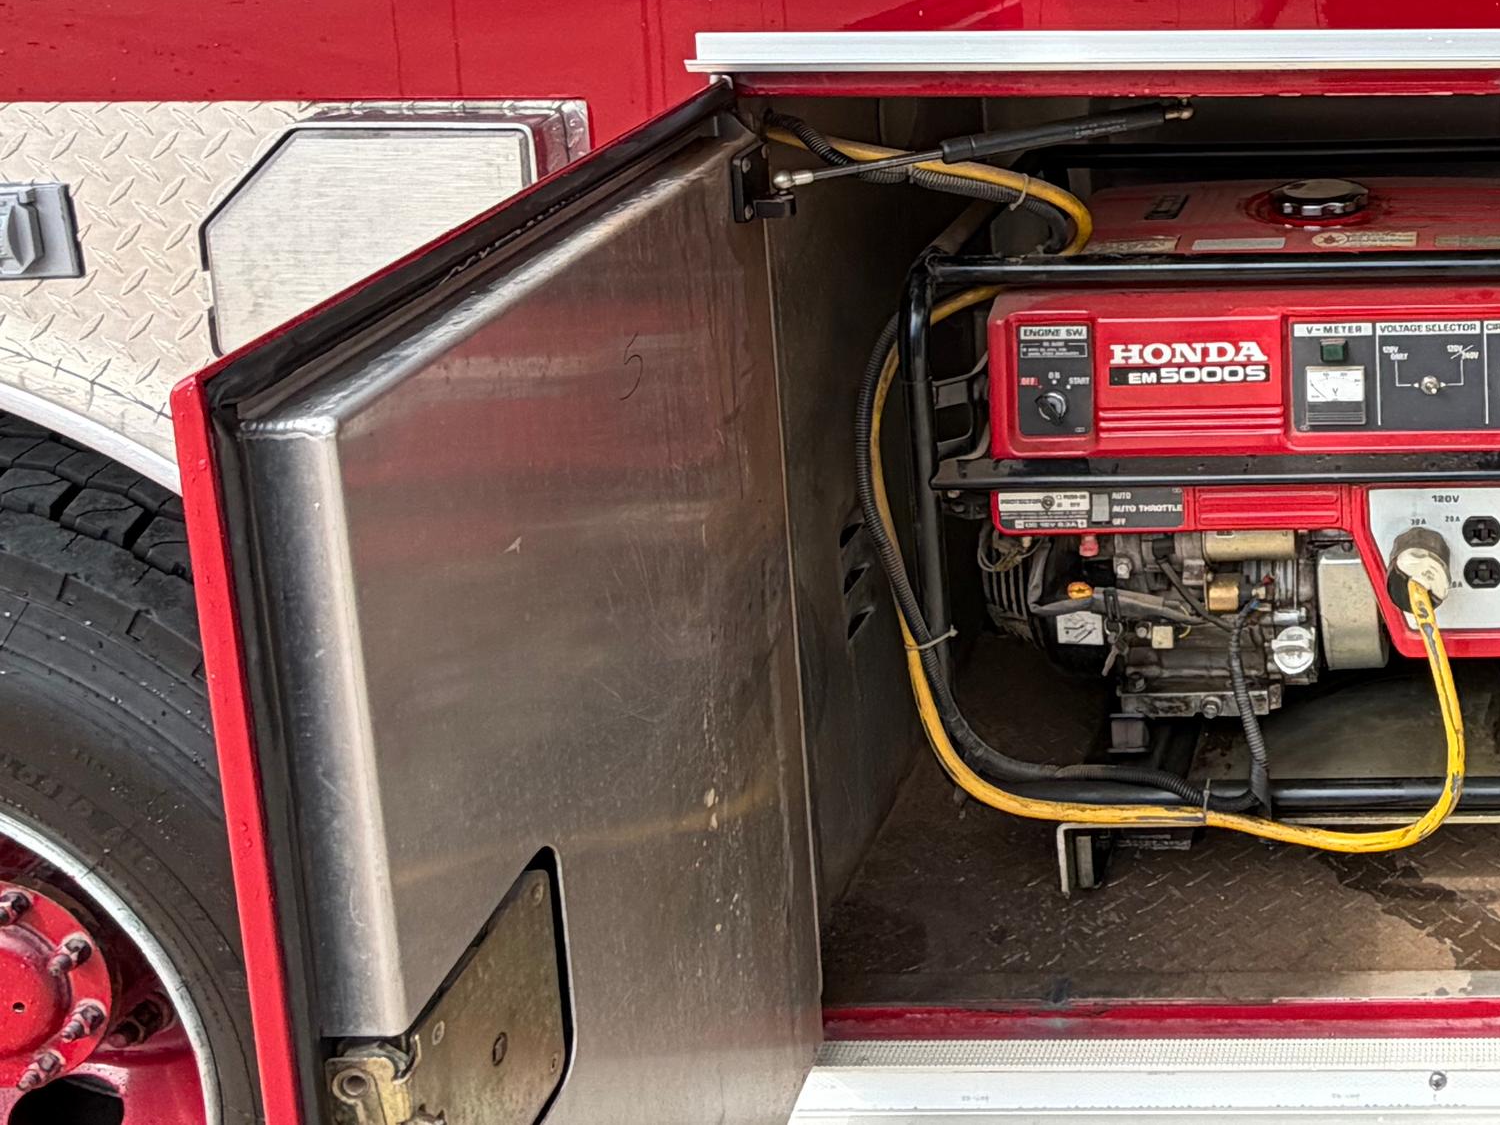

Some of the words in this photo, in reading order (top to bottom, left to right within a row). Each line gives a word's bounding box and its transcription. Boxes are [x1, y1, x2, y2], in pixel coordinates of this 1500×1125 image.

[1023, 328, 1061, 337] ENGINE
[1379, 324, 1423, 334] VOLTAGE
[1426, 323, 1477, 333] SELECTOR
[1110, 341, 1268, 365] HONDA
[1068, 377, 1090, 385] START
[1111, 491, 1132, 500] AUTO
[1431, 494, 1460, 503] 120V
[1112, 505, 1136, 513] AUTO
[1138, 504, 1183, 512] THROTTLE
